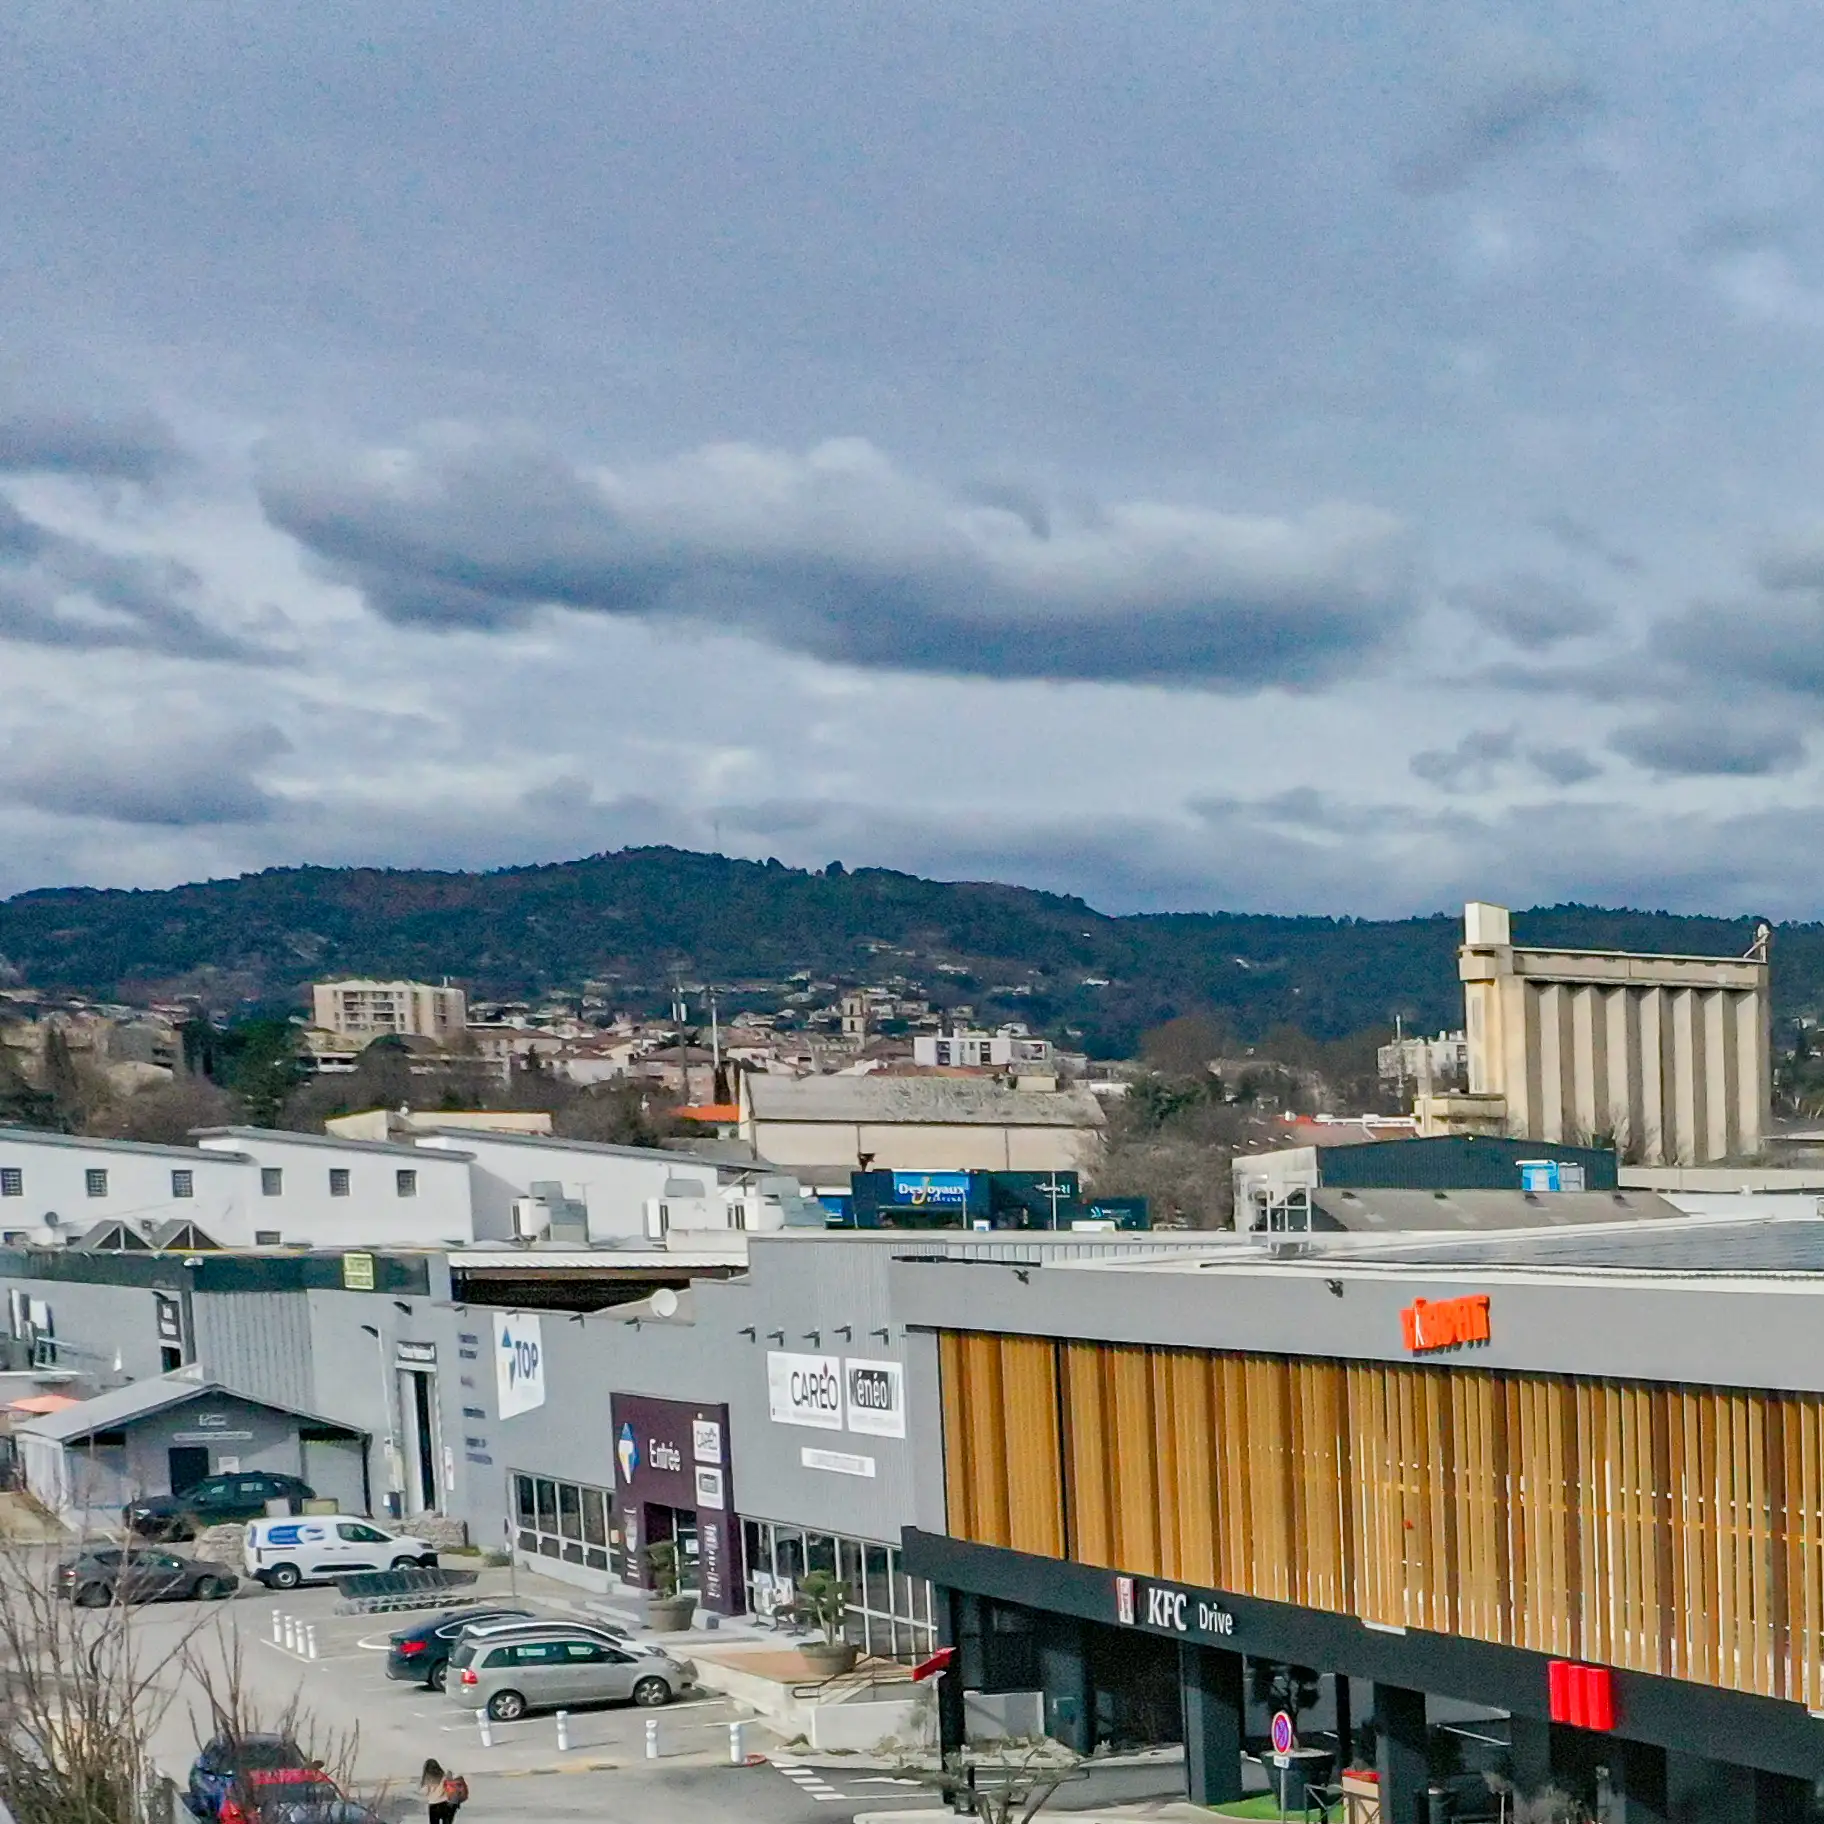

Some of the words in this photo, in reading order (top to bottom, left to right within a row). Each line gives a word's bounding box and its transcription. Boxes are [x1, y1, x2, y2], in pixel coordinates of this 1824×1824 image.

[515, 1340, 538, 1380] TOP
[1147, 1587, 1187, 1632] KFC
[1199, 1602, 1233, 1636] Drive
